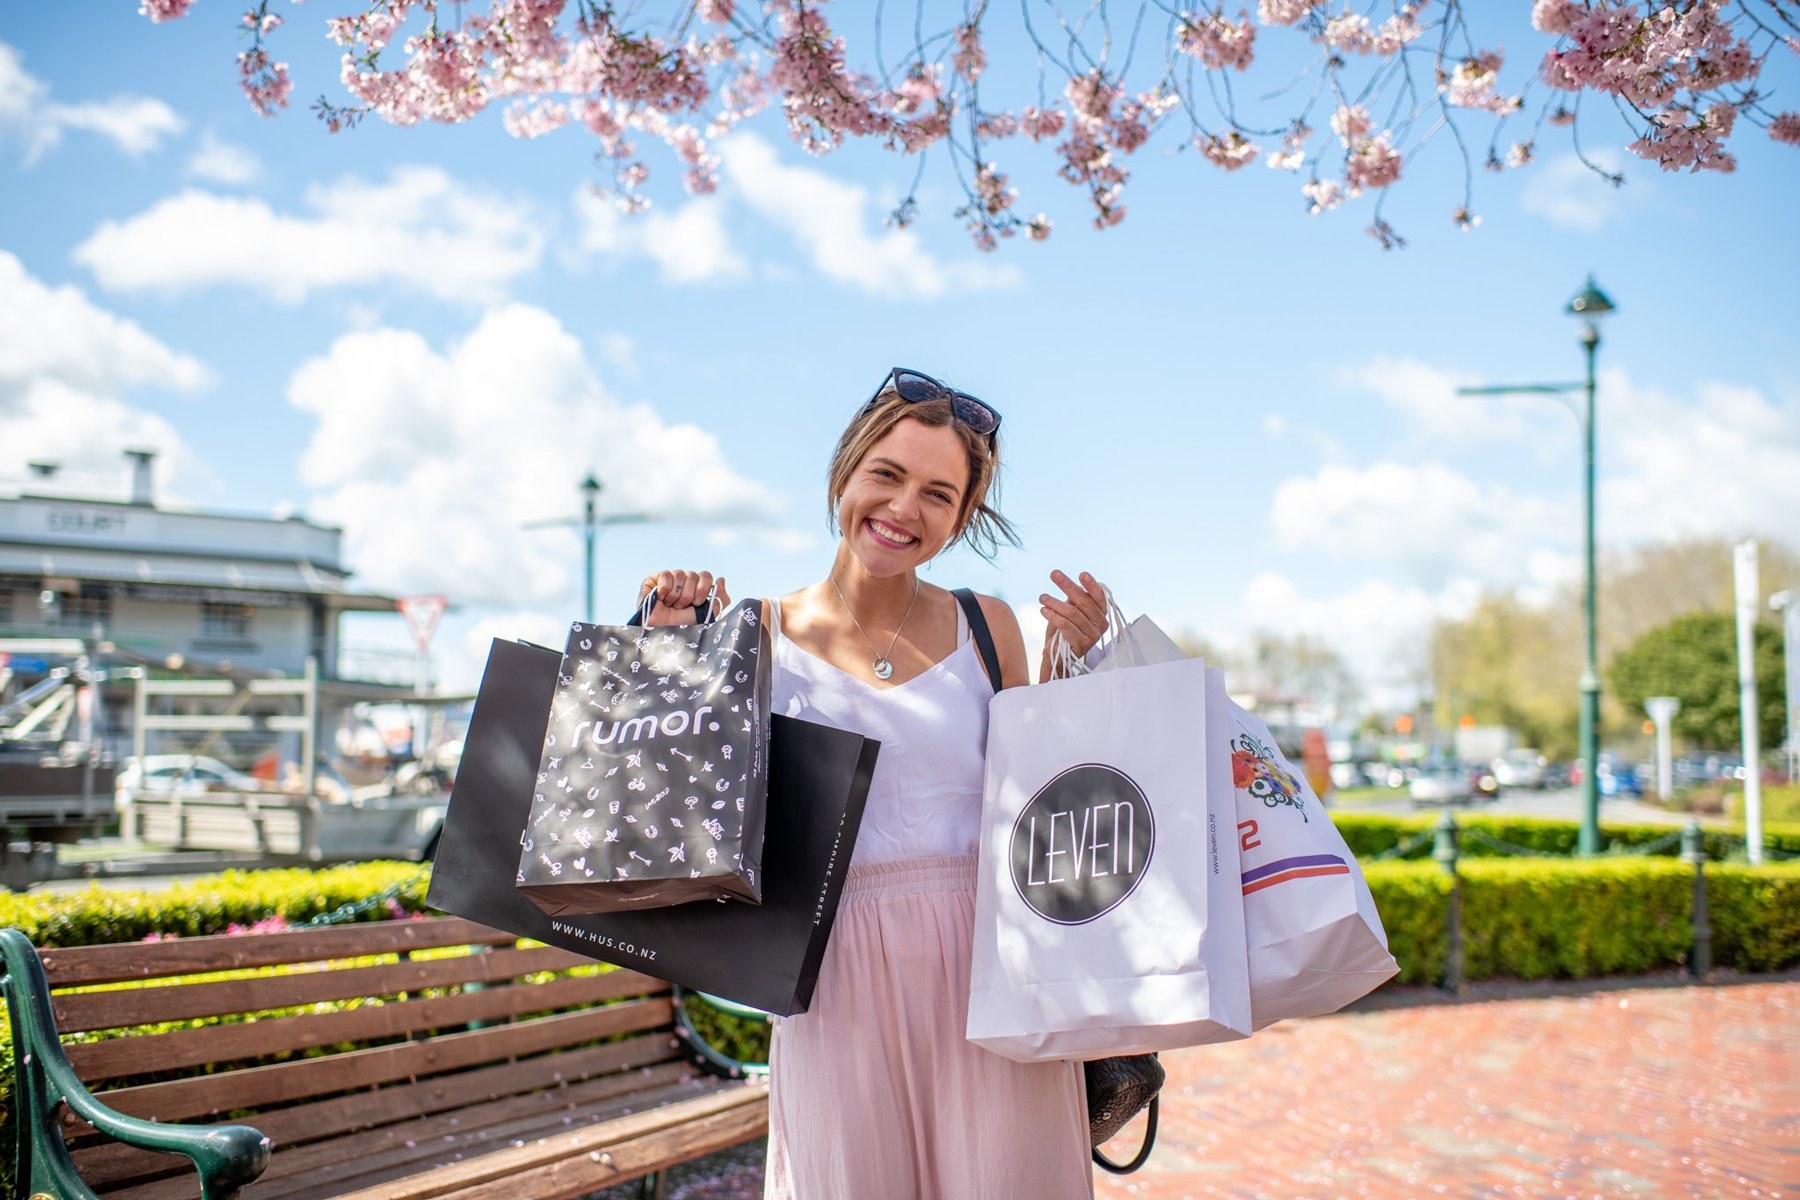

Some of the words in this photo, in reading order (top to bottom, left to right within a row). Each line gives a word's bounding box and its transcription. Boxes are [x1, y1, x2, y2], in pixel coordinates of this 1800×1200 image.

[571, 706, 720, 748] rumor.
[1028, 801, 1134, 886] LEVEN
[1210, 813, 1219, 875] www.leven.co.nz
[551, 920, 657, 961] WWW.HUS.CO.NZ
